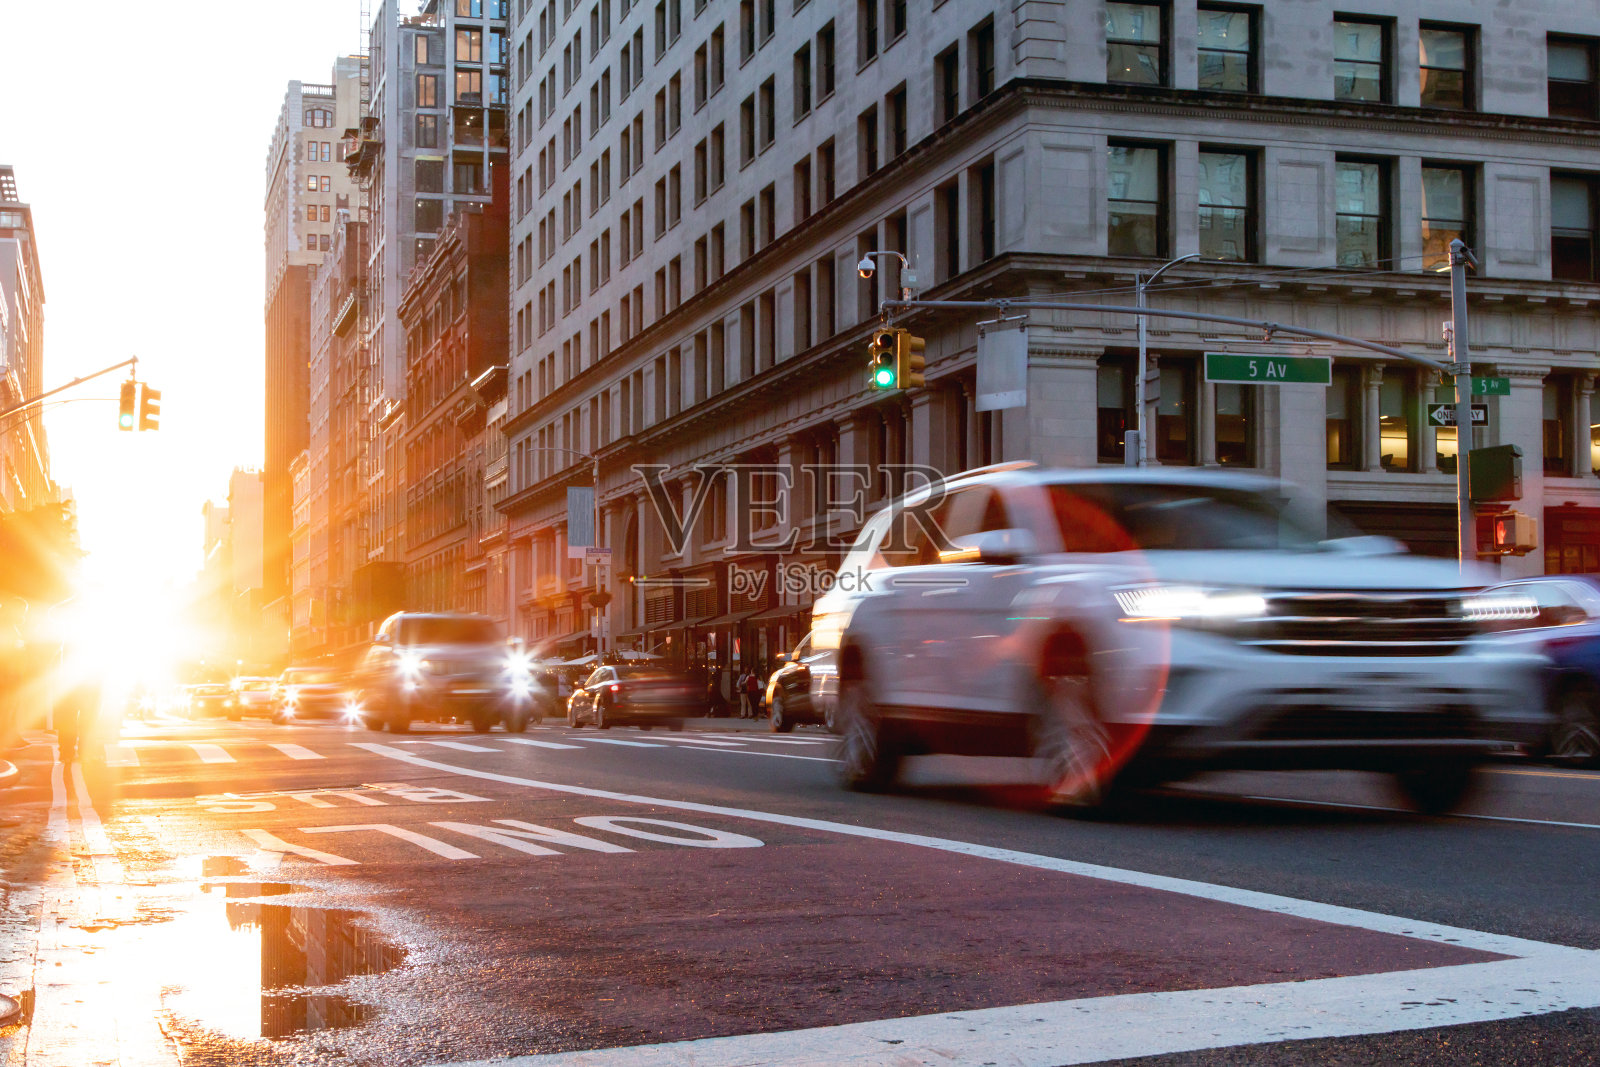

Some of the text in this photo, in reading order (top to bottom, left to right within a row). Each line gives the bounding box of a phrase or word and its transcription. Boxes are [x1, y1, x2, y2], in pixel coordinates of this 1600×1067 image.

[1249, 360, 1287, 378] 5 Av
[1481, 380, 1487, 393] 5
[1437, 410, 1455, 420] ONE
[240, 815, 766, 867] ONLY
